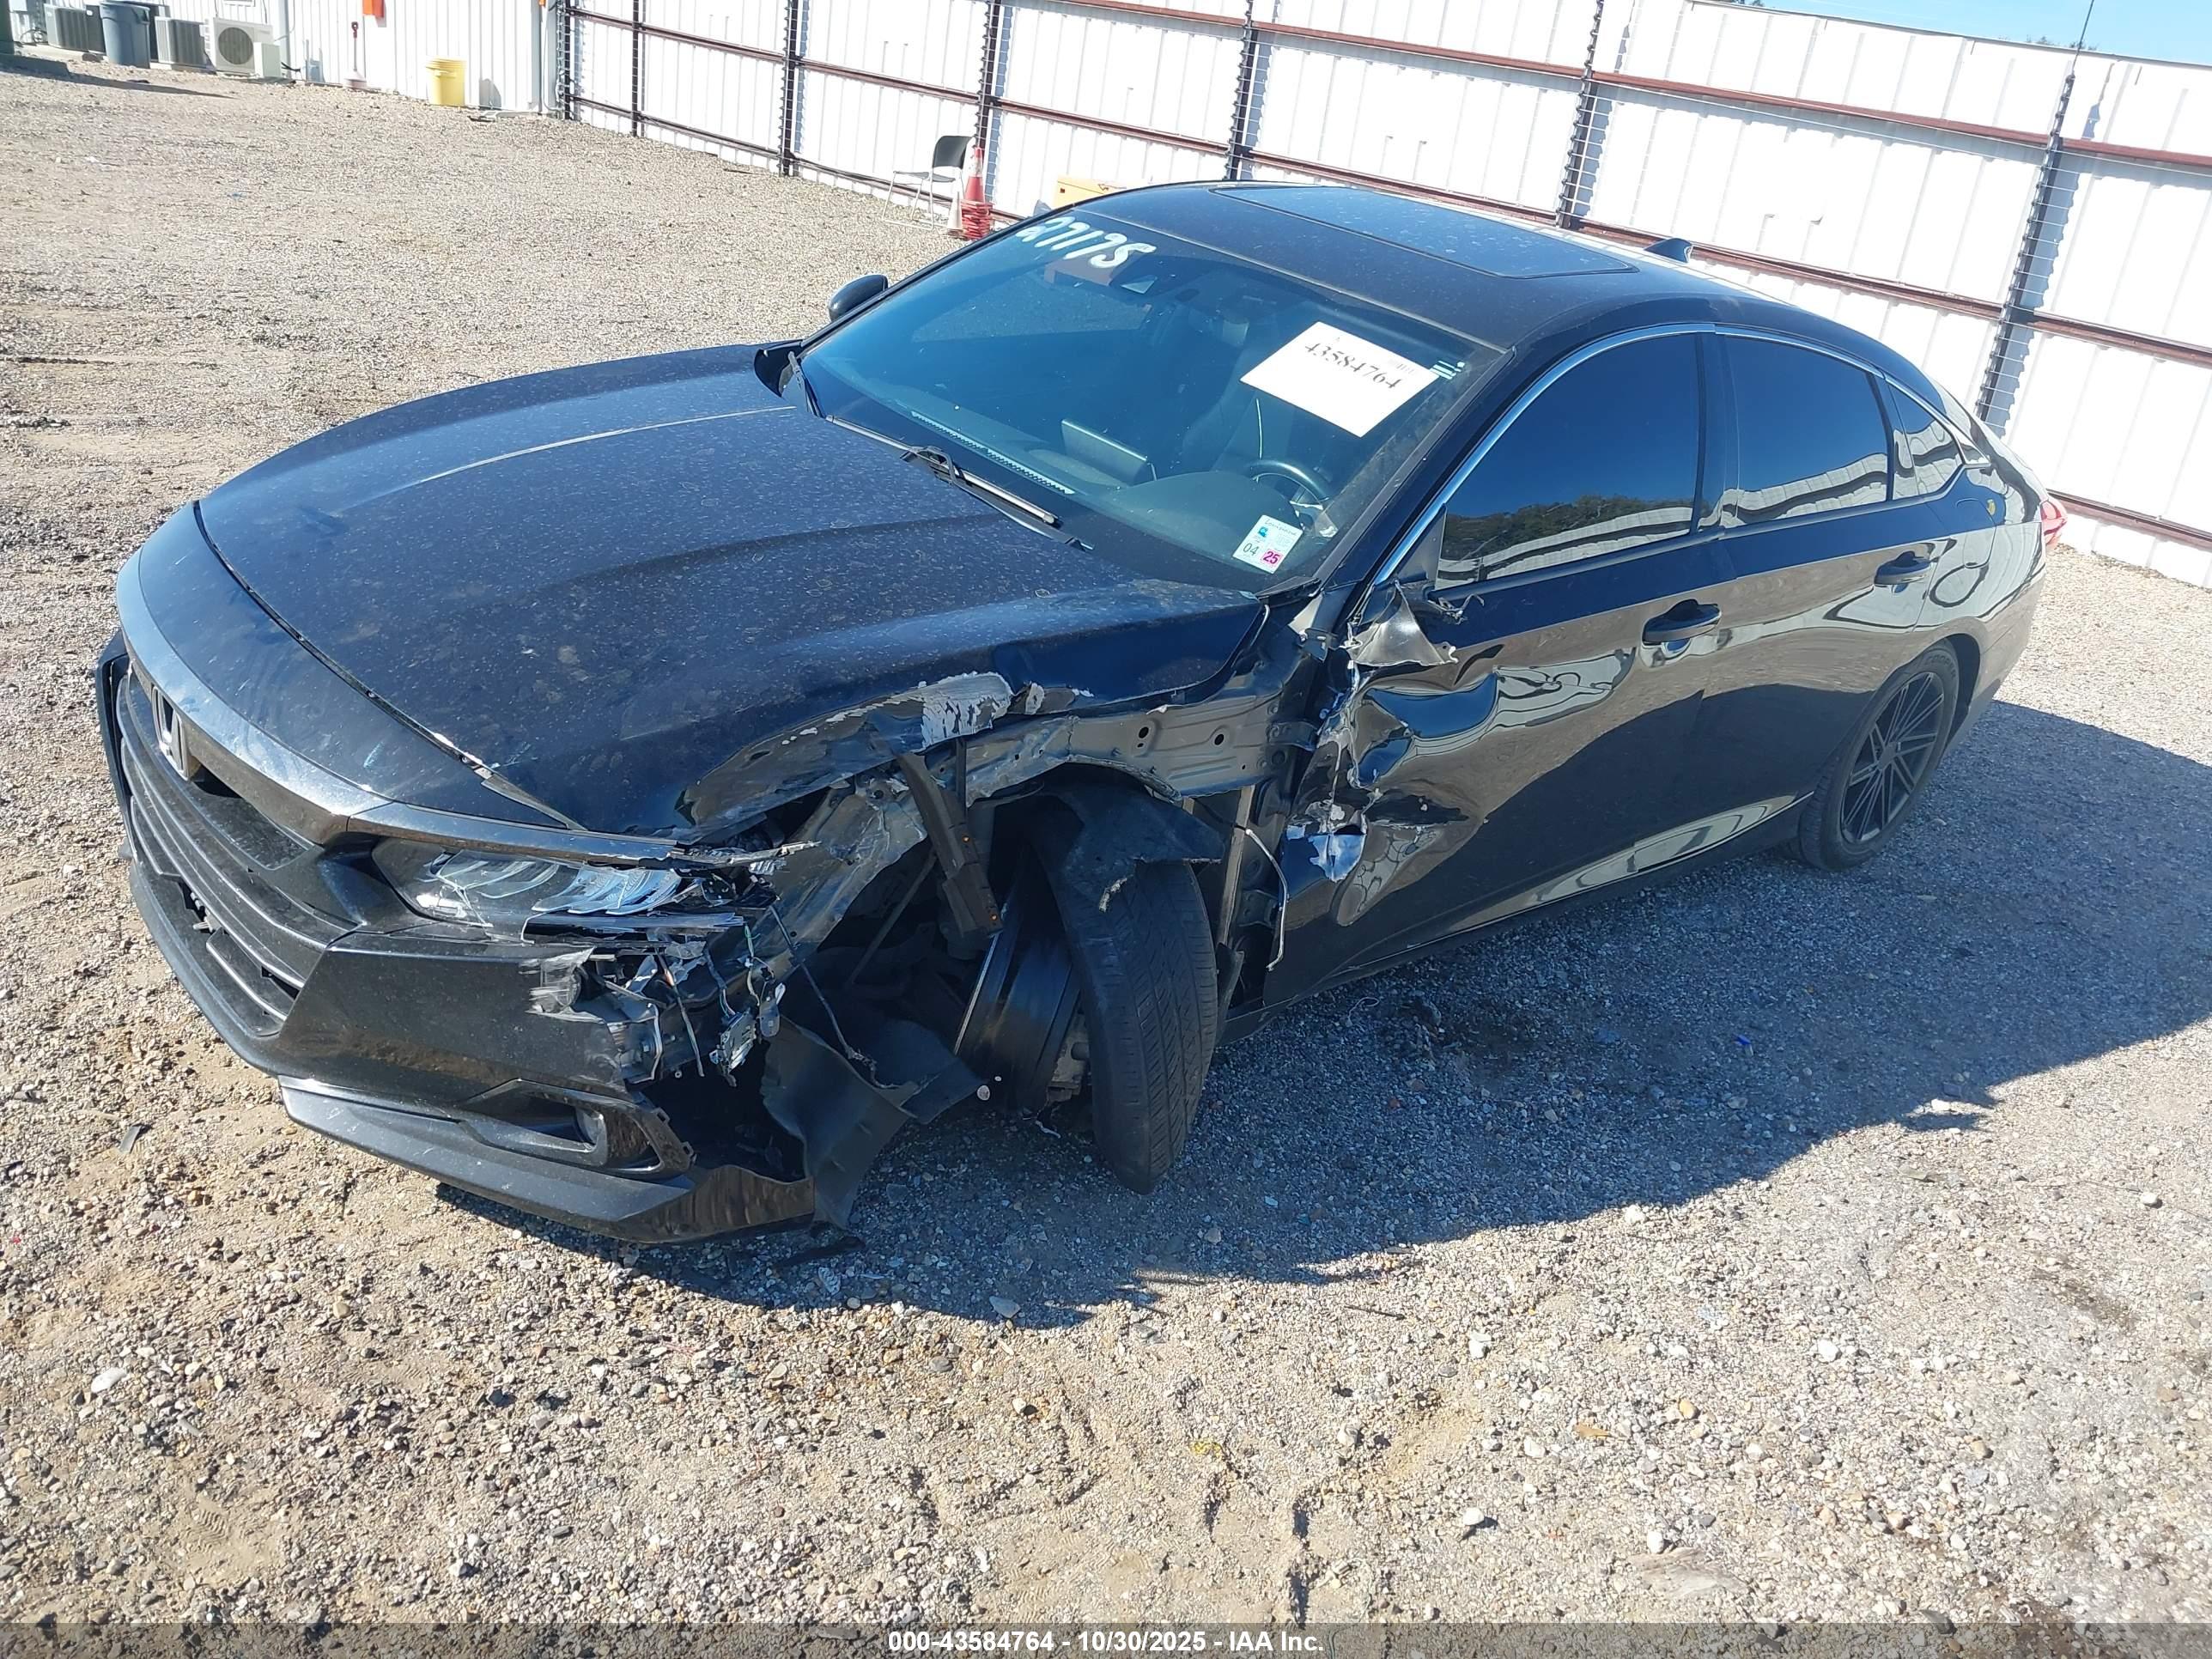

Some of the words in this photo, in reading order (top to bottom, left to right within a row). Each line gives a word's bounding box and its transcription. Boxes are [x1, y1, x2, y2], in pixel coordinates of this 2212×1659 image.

[1305, 343, 1401, 389] 43584764
[1243, 543, 1259, 556] 04
[1263, 550, 1280, 564] 25
